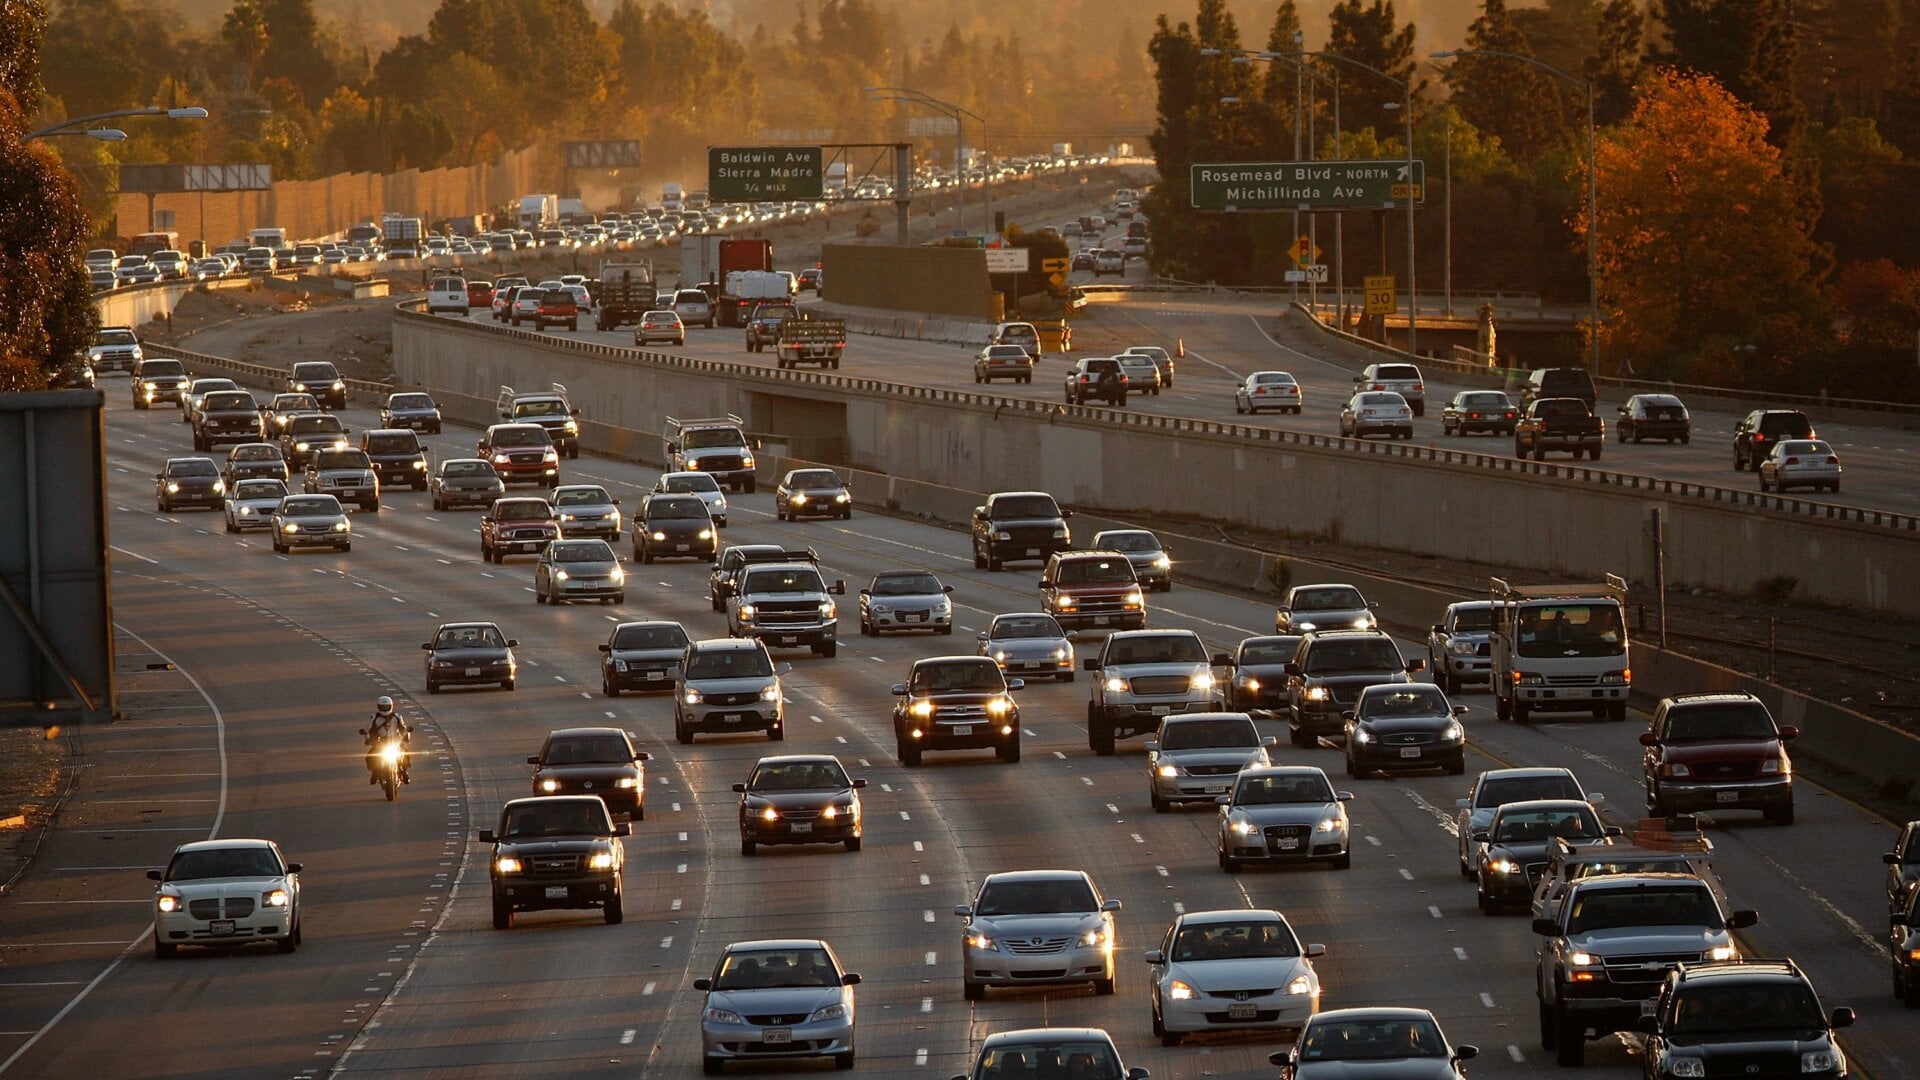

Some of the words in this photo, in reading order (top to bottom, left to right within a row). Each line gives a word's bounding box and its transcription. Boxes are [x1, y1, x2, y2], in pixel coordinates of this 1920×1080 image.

[720, 152, 775, 163] Baldwin
[785, 152, 811, 162] Ave
[718, 167, 761, 178] Sierra
[770, 167, 813, 177] Madre
[1201, 168, 1283, 182] Rosemead
[1295, 168, 1331, 180] Blvd
[1346, 169, 1389, 179] NORTH
[744, 183, 759, 192] 3/4
[1226, 186, 1320, 200] Michillinda
[1333, 186, 1364, 198] Ave
[1392, 186, 1418, 197] ONY
[1370, 292, 1390, 305] 30
